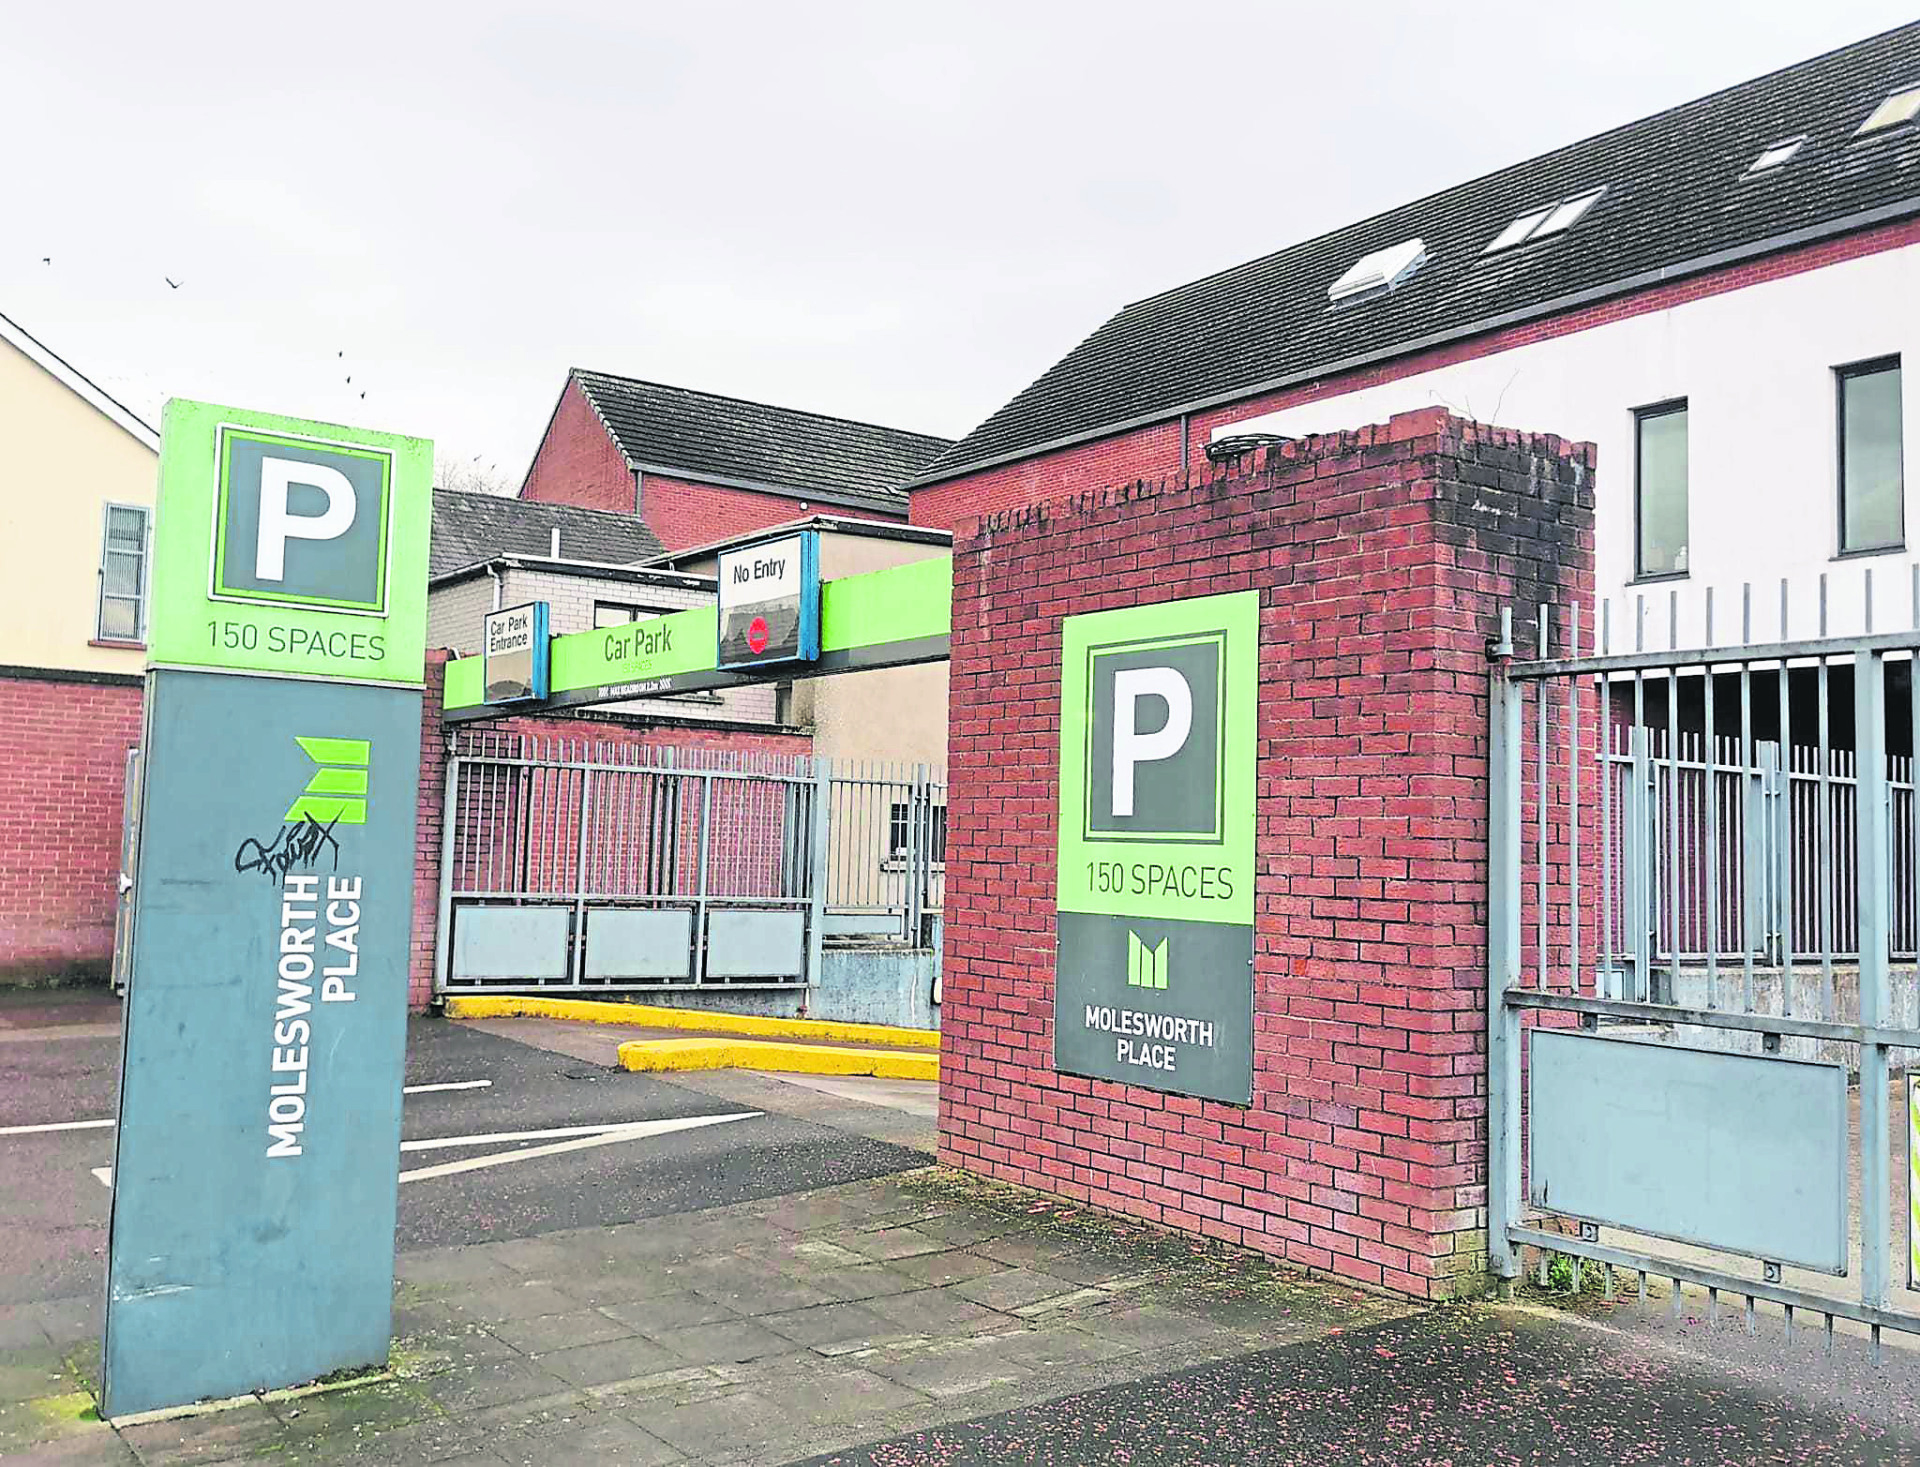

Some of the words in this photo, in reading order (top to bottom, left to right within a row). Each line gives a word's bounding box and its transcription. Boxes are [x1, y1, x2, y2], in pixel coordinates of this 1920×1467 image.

[255, 456, 357, 582] P
[733, 564, 750, 585] No
[754, 558, 785, 580] Entry
[208, 621, 258, 650] 150
[268, 626, 386, 661] SPACES
[490, 620, 505, 636] Car
[508, 613, 528, 632] Park
[490, 633, 528, 653] Entrance
[604, 633, 631, 661] Car
[635, 623, 672, 657] Park
[1111, 667, 1193, 817] P
[1087, 862, 1124, 893] 150
[1131, 863, 1233, 900] SPACES
[321, 876, 362, 1002] PLACE
[266, 875, 319, 1158] MOLESWORTH
[1085, 1004, 1214, 1048] MOLESWORTH
[1117, 1038, 1176, 1072] PLACE
